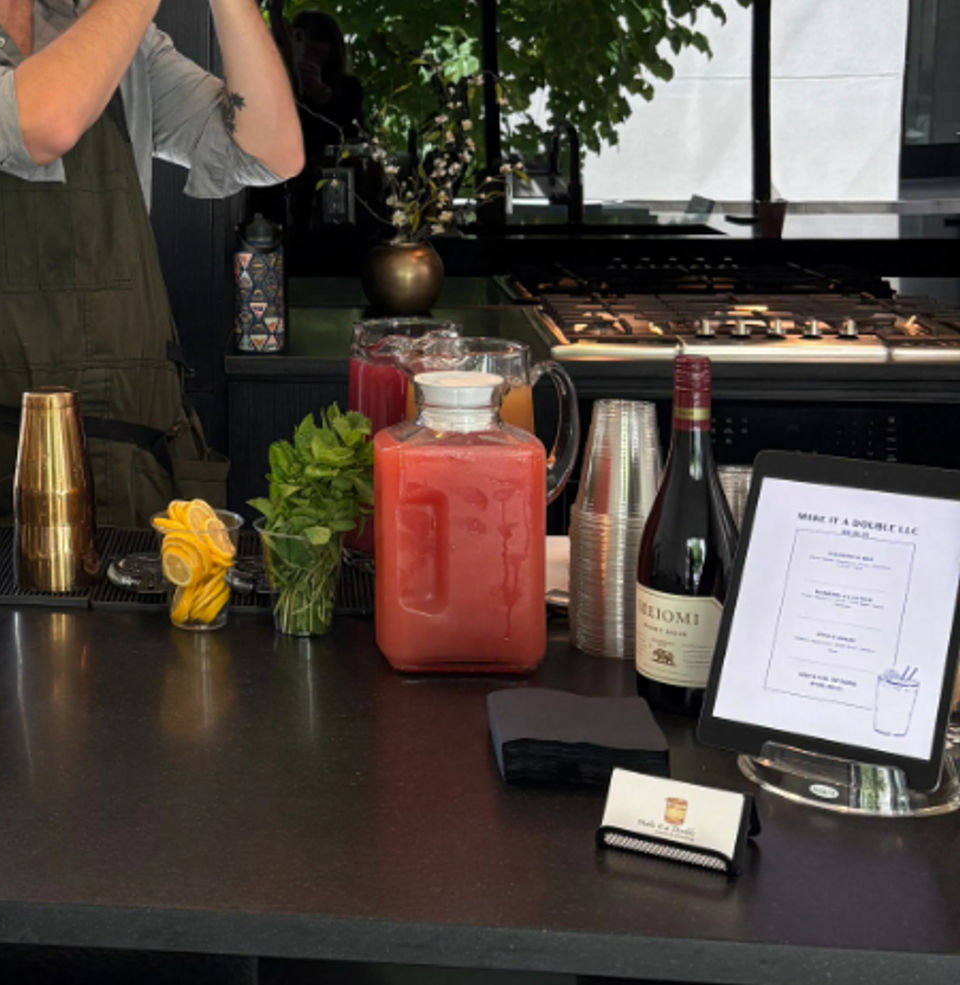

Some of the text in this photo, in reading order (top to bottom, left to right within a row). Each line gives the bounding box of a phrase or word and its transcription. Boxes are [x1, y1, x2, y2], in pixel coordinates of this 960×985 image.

[829, 516, 839, 525] IT
[842, 518, 849, 527] A
[852, 519, 897, 534] DOUBLE
[898, 525, 919, 537] LLC
